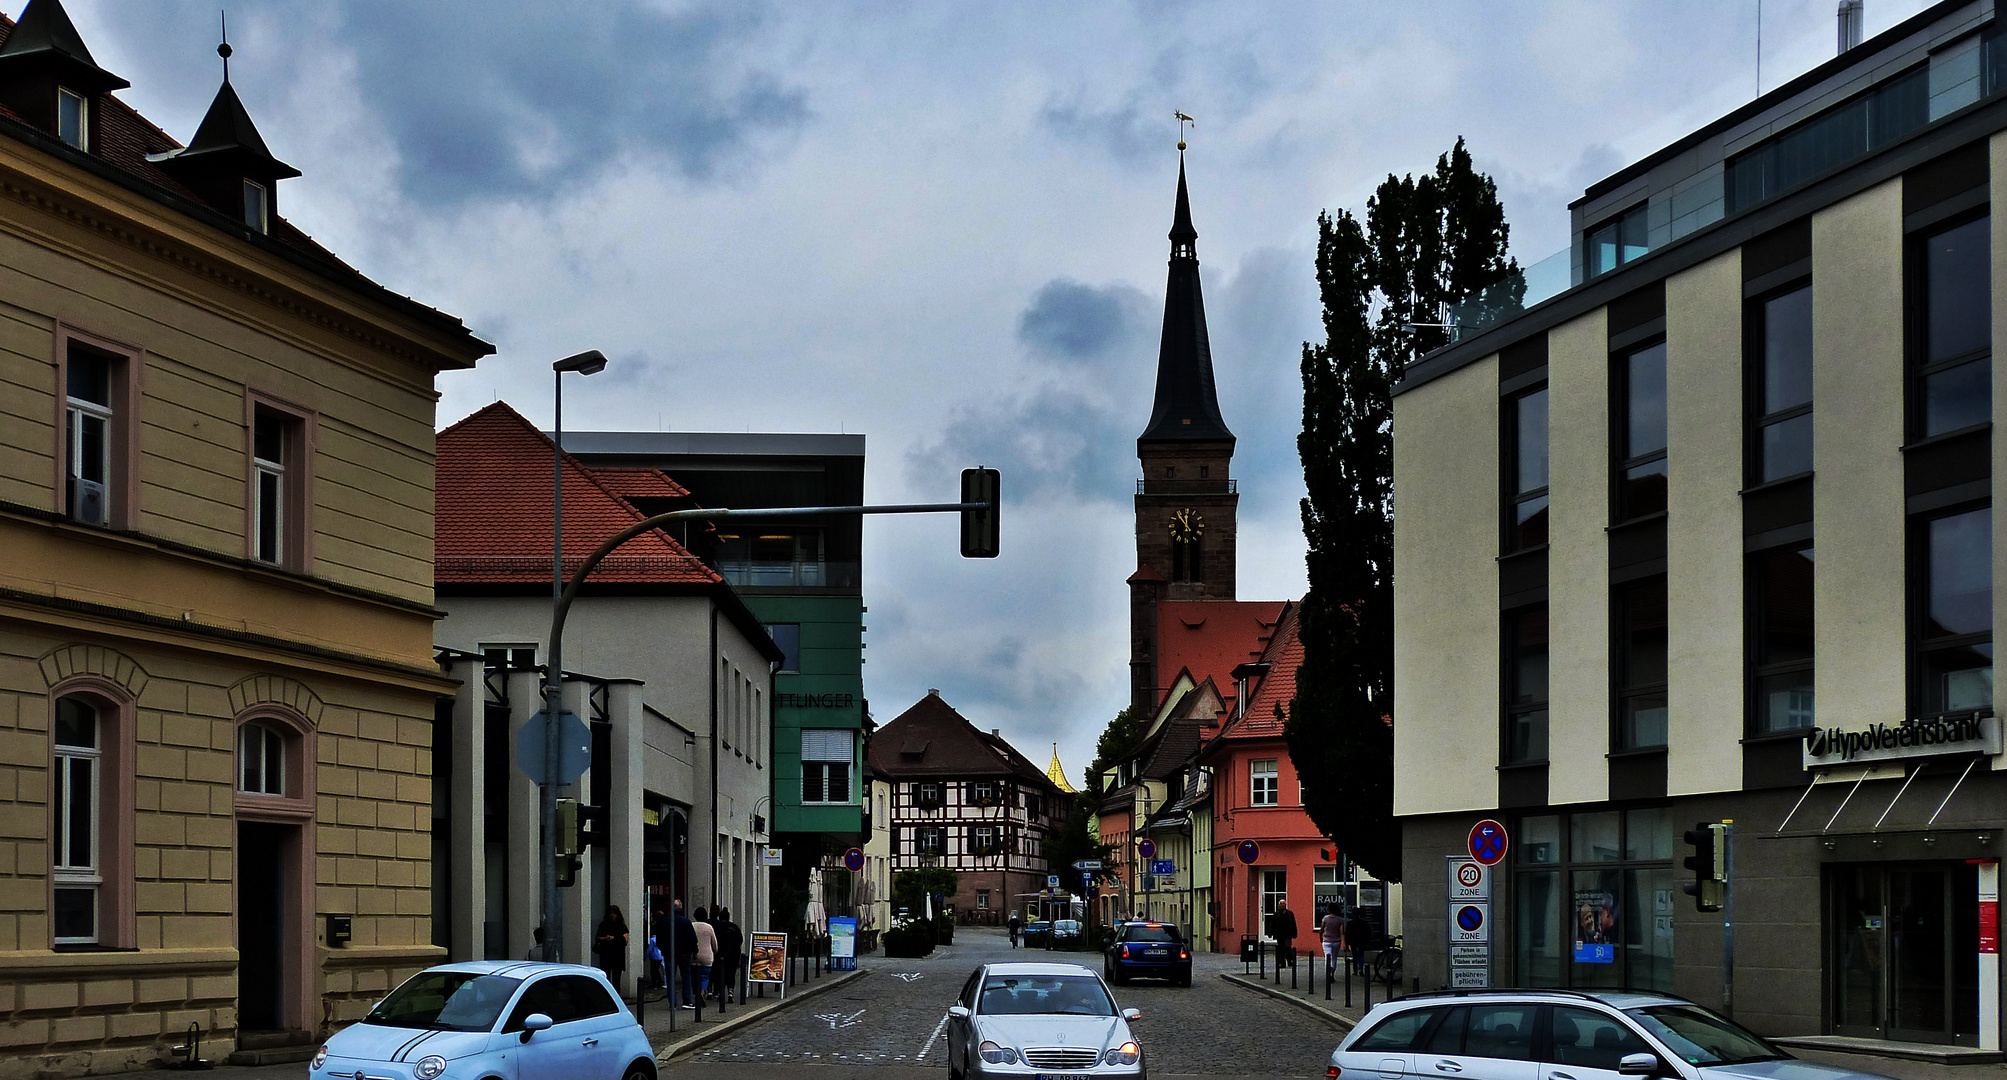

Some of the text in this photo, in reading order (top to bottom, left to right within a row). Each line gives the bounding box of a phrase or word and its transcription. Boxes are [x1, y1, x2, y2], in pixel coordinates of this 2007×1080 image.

[1828, 712, 1984, 761] HypoVereinsbank
[1462, 869, 1477, 881] 20
[1460, 888, 1480, 896] ZONE
[1460, 932, 1480, 940] ZONE
